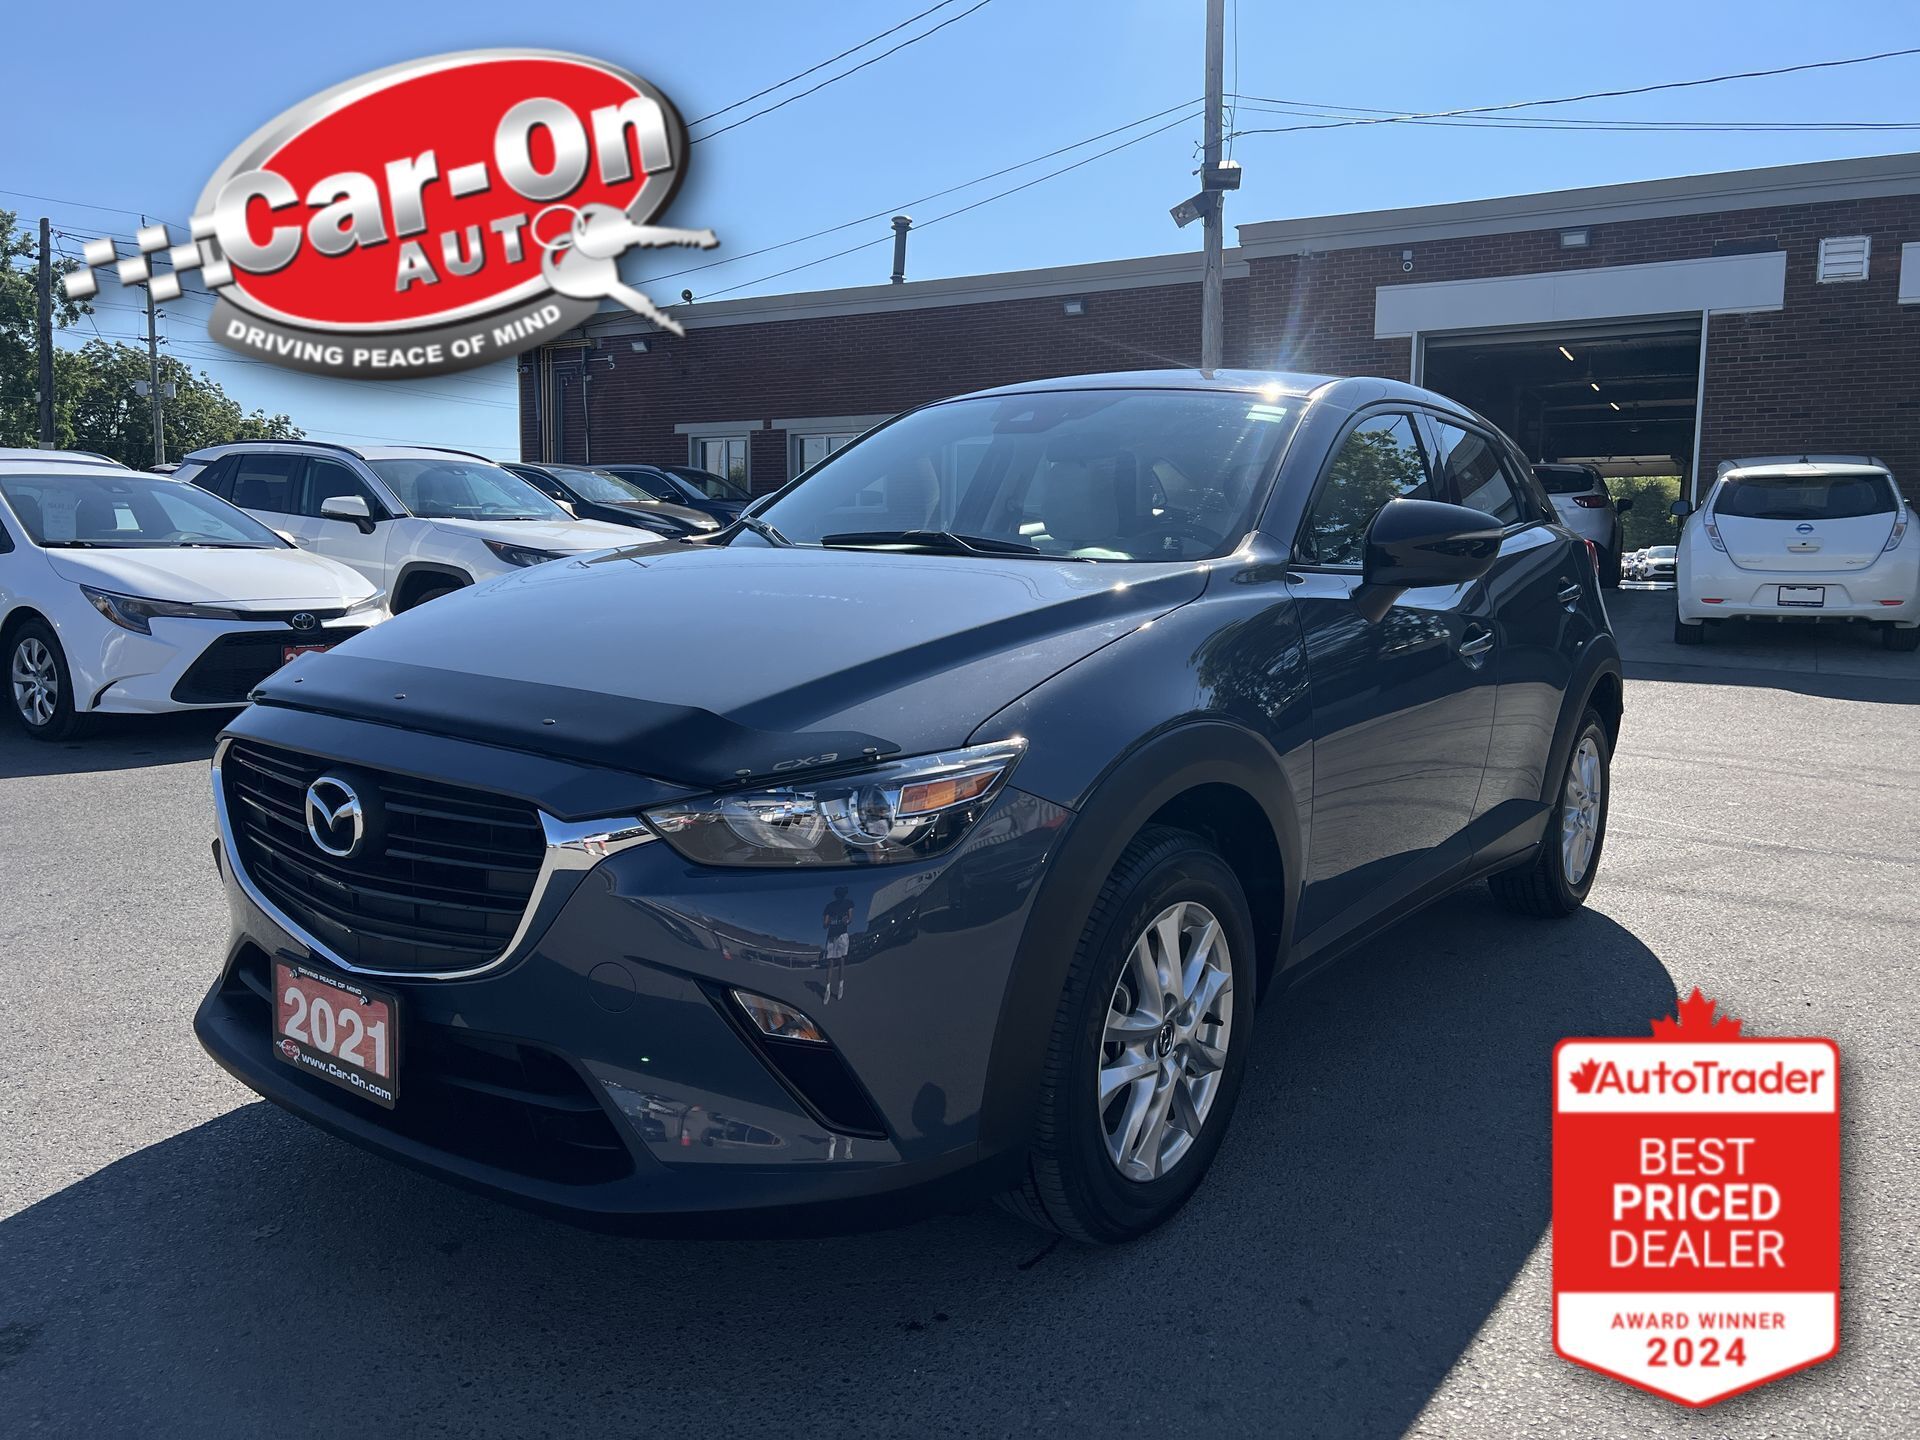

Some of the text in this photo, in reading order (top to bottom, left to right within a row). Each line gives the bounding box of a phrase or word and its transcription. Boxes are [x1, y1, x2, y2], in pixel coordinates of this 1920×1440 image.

[772, 753, 838, 770] CX-3
[284, 987, 386, 1077] 2021
[301, 1053, 392, 1101] www.Car-On.com
